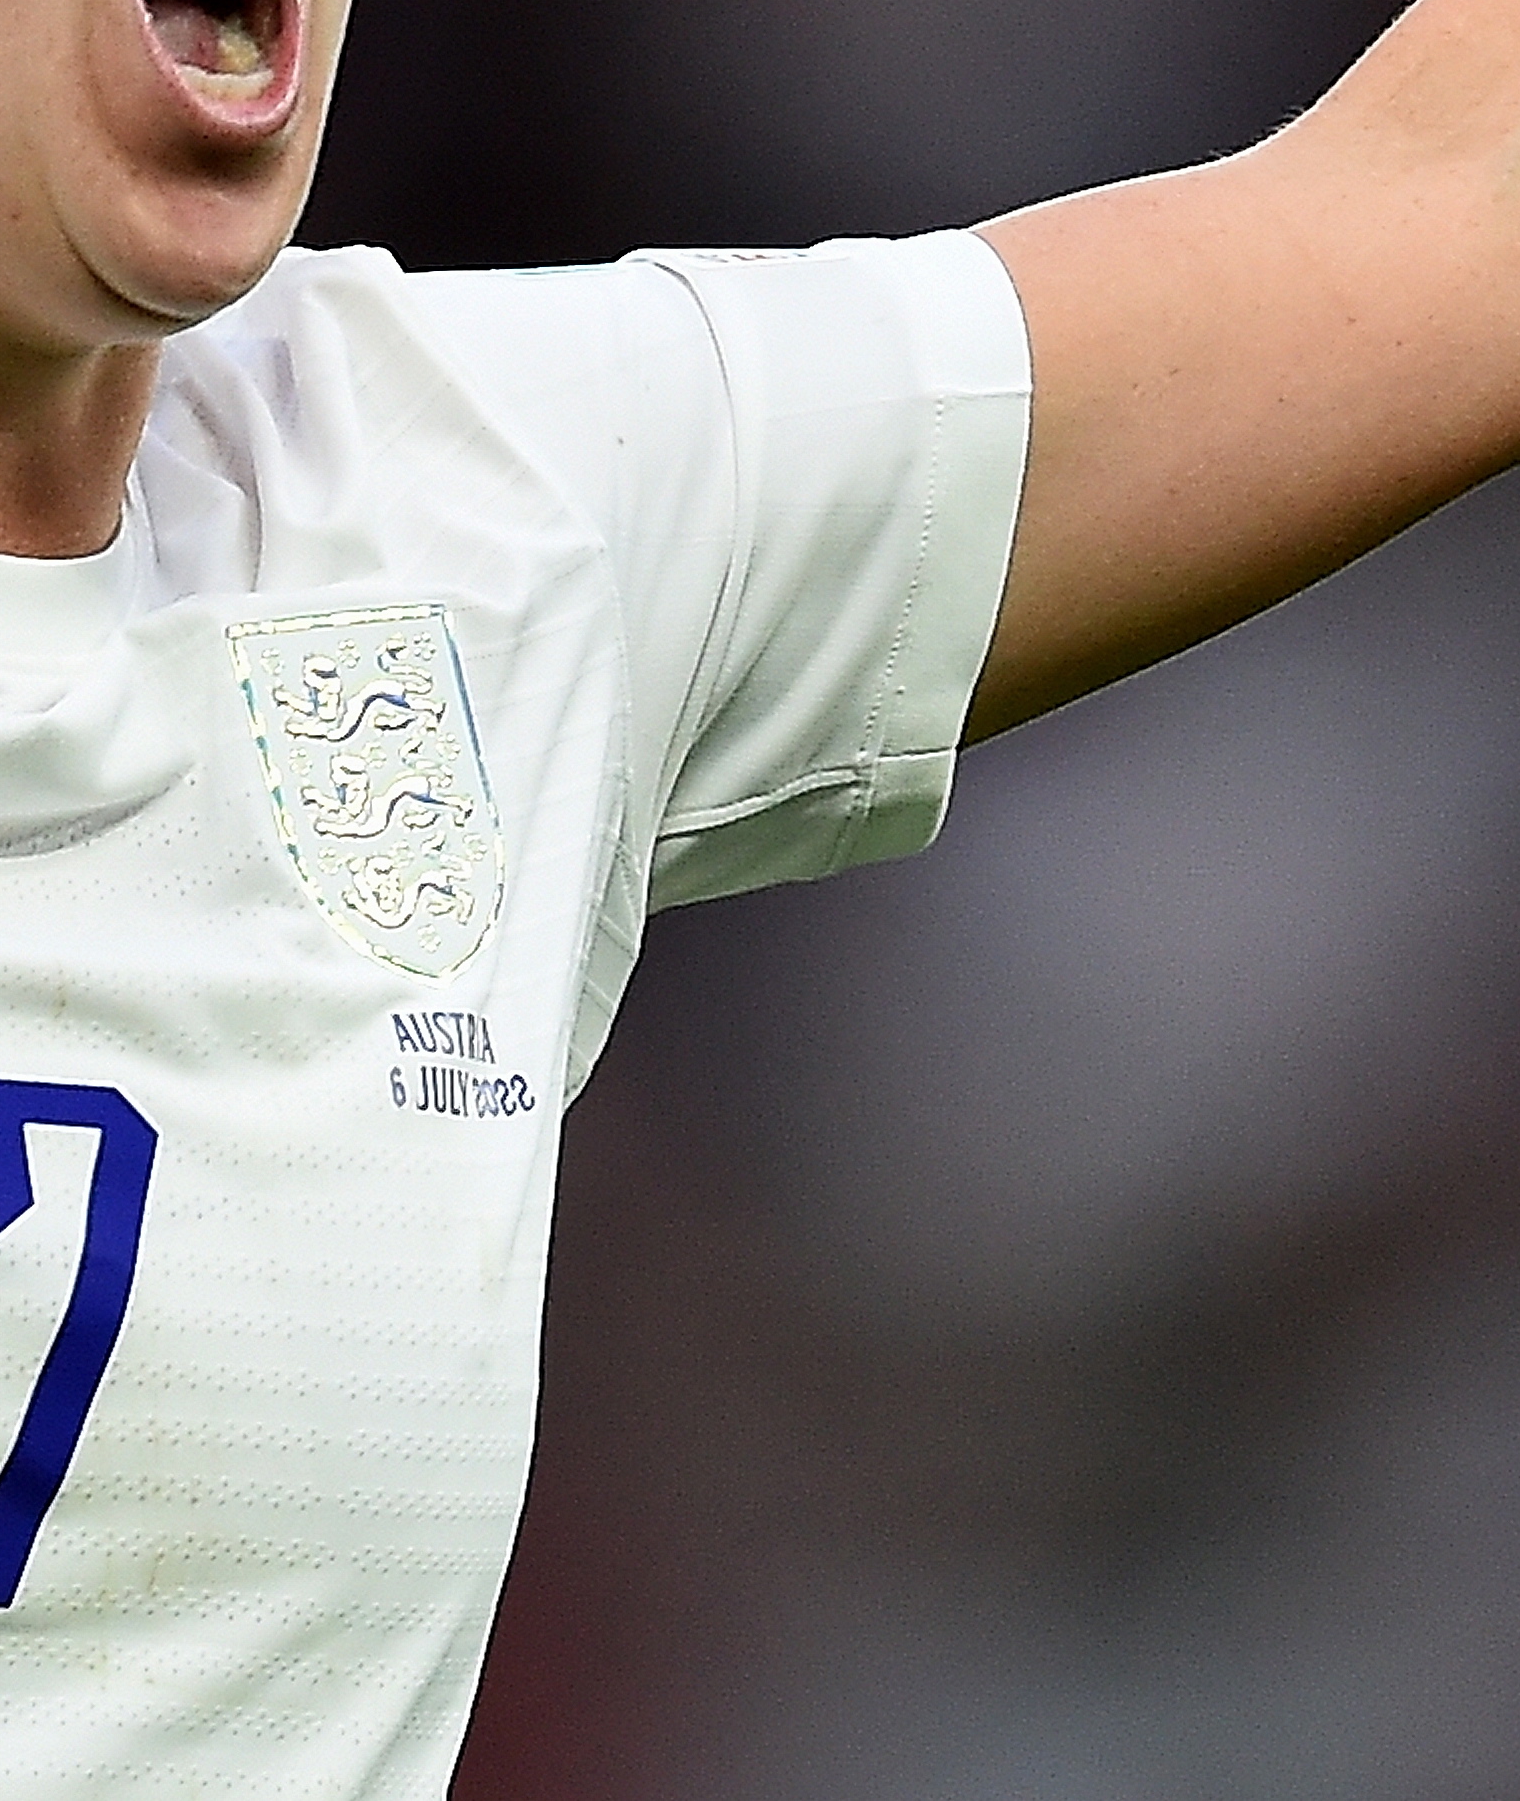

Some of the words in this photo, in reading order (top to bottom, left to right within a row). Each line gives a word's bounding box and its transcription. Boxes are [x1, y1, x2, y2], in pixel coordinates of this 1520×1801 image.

[391, 1012, 496, 1064] AUSTRIA
[390, 1066, 406, 1108] 6
[416, 1066, 469, 1117] JULY
